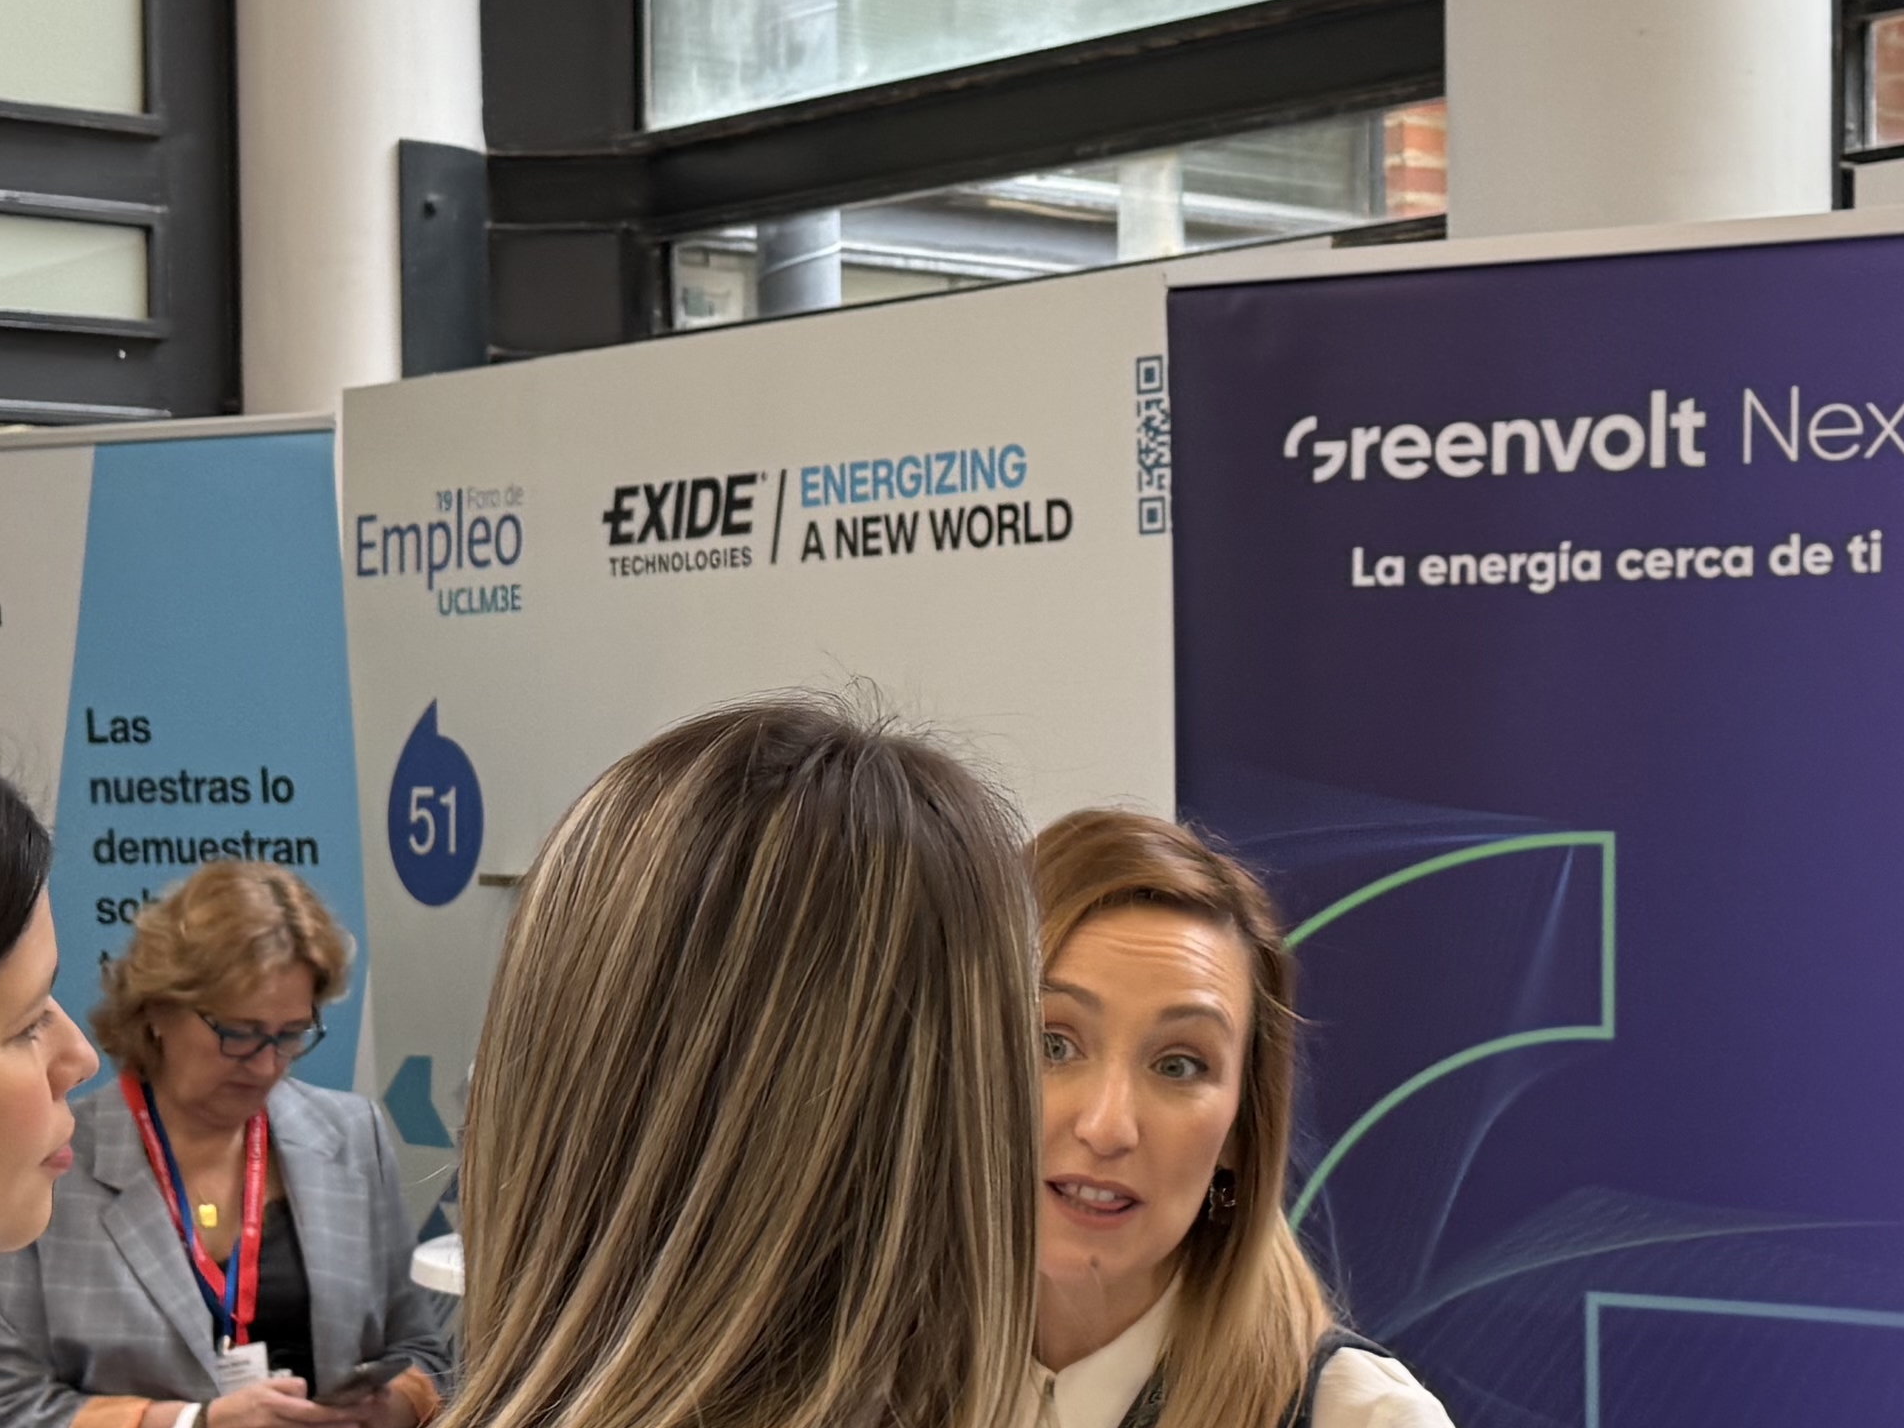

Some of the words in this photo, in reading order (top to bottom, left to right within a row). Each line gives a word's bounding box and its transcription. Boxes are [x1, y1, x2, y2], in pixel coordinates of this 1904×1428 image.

[1283, 389, 1707, 483] Greenvolt
[467, 487, 501, 510] Foro
[504, 483, 525, 507] de
[801, 443, 1028, 509] ENERGIZING
[357, 487, 523, 591] Empleo
[602, 472, 758, 547] EXIDE
[801, 521, 825, 563] A
[835, 511, 919, 559] NEW
[929, 498, 1073, 552] WORLD
[609, 545, 753, 578] TECHNOLOGIES
[1352, 547, 1404, 588] La
[1419, 540, 1602, 594] energía
[1616, 545, 1755, 580] cerca
[1769, 533, 1834, 576] de
[1847, 529, 1883, 574] ti
[438, 584, 523, 616] UCLM3E
[86, 706, 152, 745] Las
[89, 769, 252, 805] nuestras
[260, 764, 295, 804] lo
[93, 827, 319, 866] demuestran
[408, 786, 459, 857] 51
